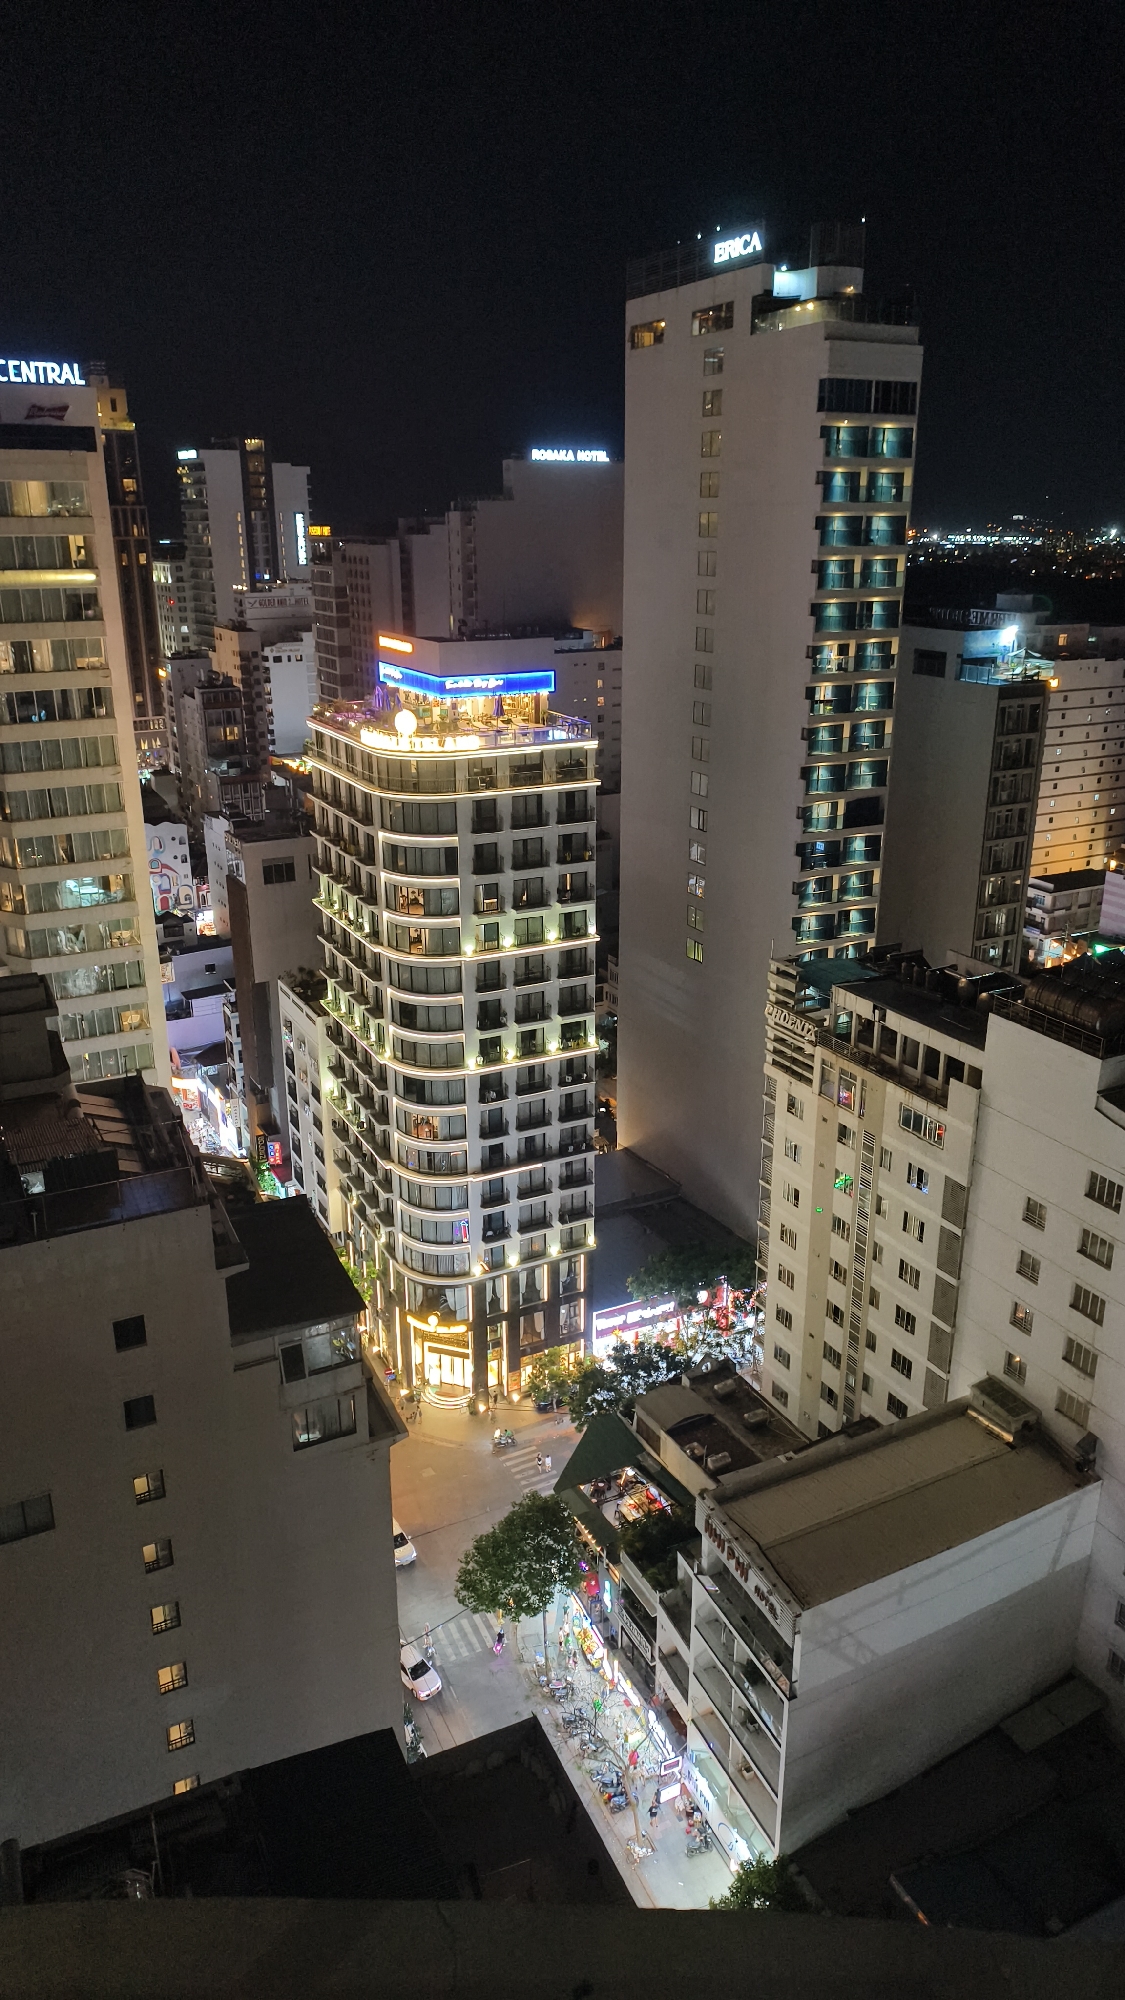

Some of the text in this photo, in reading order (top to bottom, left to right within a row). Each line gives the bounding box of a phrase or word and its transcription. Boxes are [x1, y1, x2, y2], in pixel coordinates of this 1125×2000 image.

[714, 231, 763, 264] ERICA
[0, 358, 85, 385] CENTRAL
[577, 449, 610, 462] HOTEL
[765, 1003, 816, 1042] PHOENIX
[726, 1545, 749, 1583] PHI
